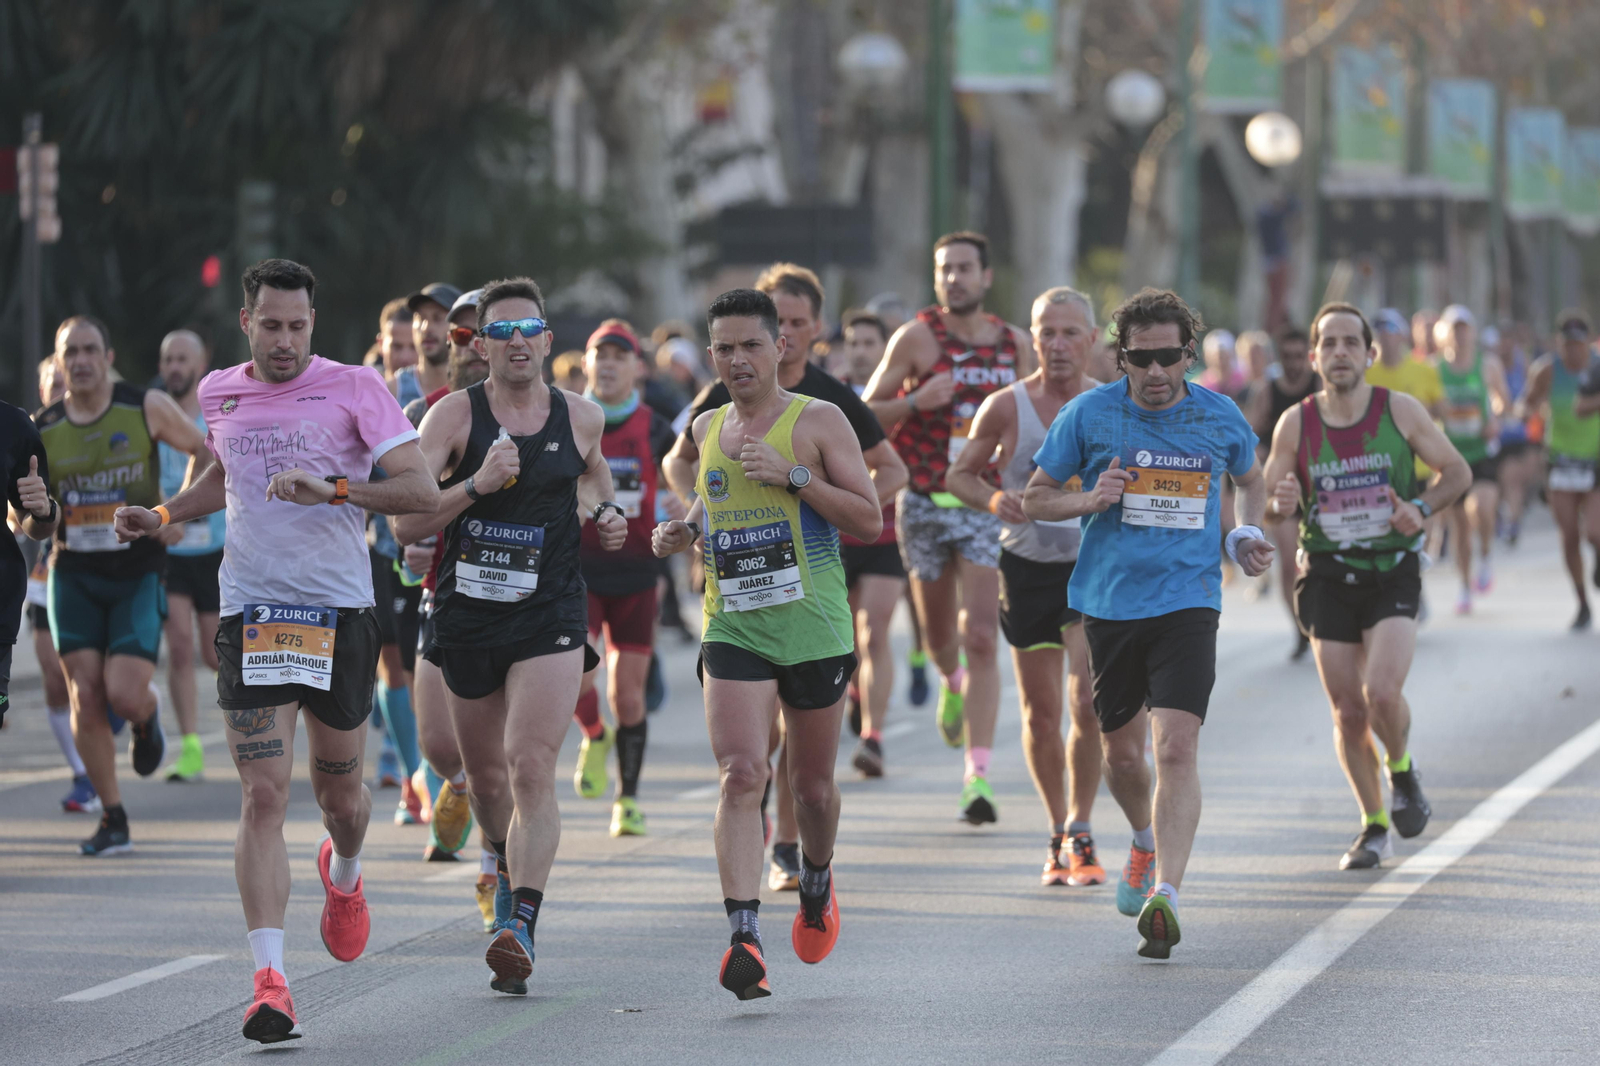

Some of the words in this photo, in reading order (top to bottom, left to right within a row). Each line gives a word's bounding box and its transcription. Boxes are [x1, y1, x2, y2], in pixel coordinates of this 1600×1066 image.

[1154, 455, 1202, 468] ZURICH
[1153, 479, 1182, 492] 3429
[1337, 474, 1380, 490] ZURICH
[1150, 498, 1180, 509] TIJOLA
[712, 506, 787, 524] ESTEPONA
[484, 526, 533, 541] ZURICH
[733, 527, 781, 545] ZURICH
[480, 550, 511, 565] 2144
[737, 556, 767, 572] 3062
[479, 569, 507, 582] DAVID
[738, 574, 775, 590] JUÁREZ
[274, 633, 303, 648] 4275
[247, 652, 285, 665] ADRIÁN
[286, 653, 328, 670] MÁRQUE
[236, 738, 283, 753] ERES
[238, 749, 284, 762] FUEGO
[315, 754, 358, 768] AHORA
